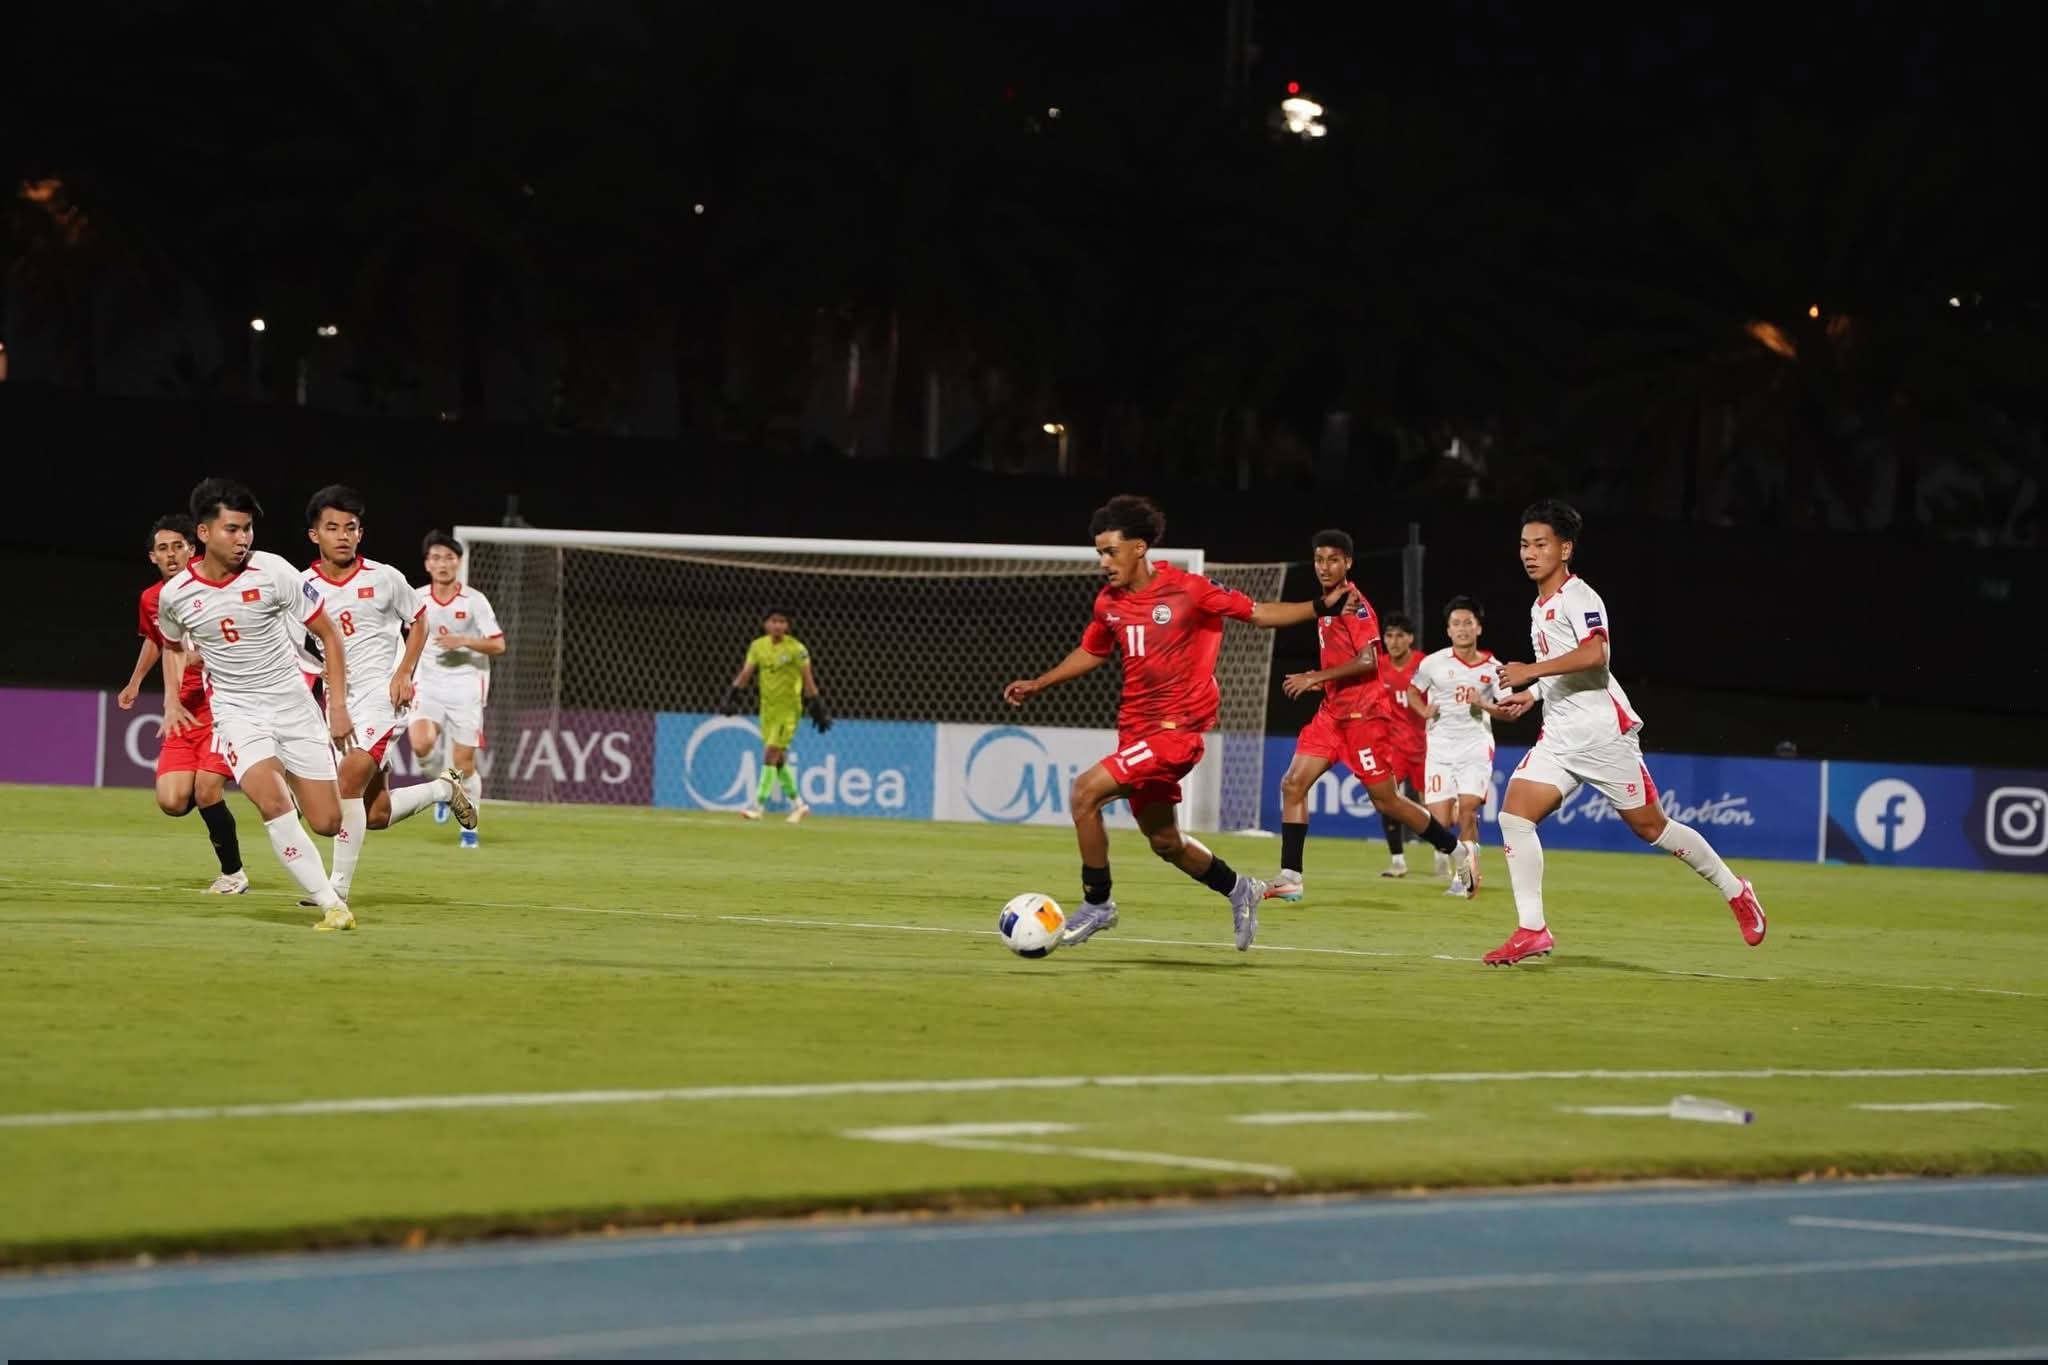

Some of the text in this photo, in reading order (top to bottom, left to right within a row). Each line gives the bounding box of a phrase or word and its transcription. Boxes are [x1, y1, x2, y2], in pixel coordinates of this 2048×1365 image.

[220, 618, 240, 643] 6
[340, 611, 355, 637] 8
[1126, 625, 1145, 657] 11
[1120, 740, 1153, 767] 11
[1358, 747, 1376, 771] 6
